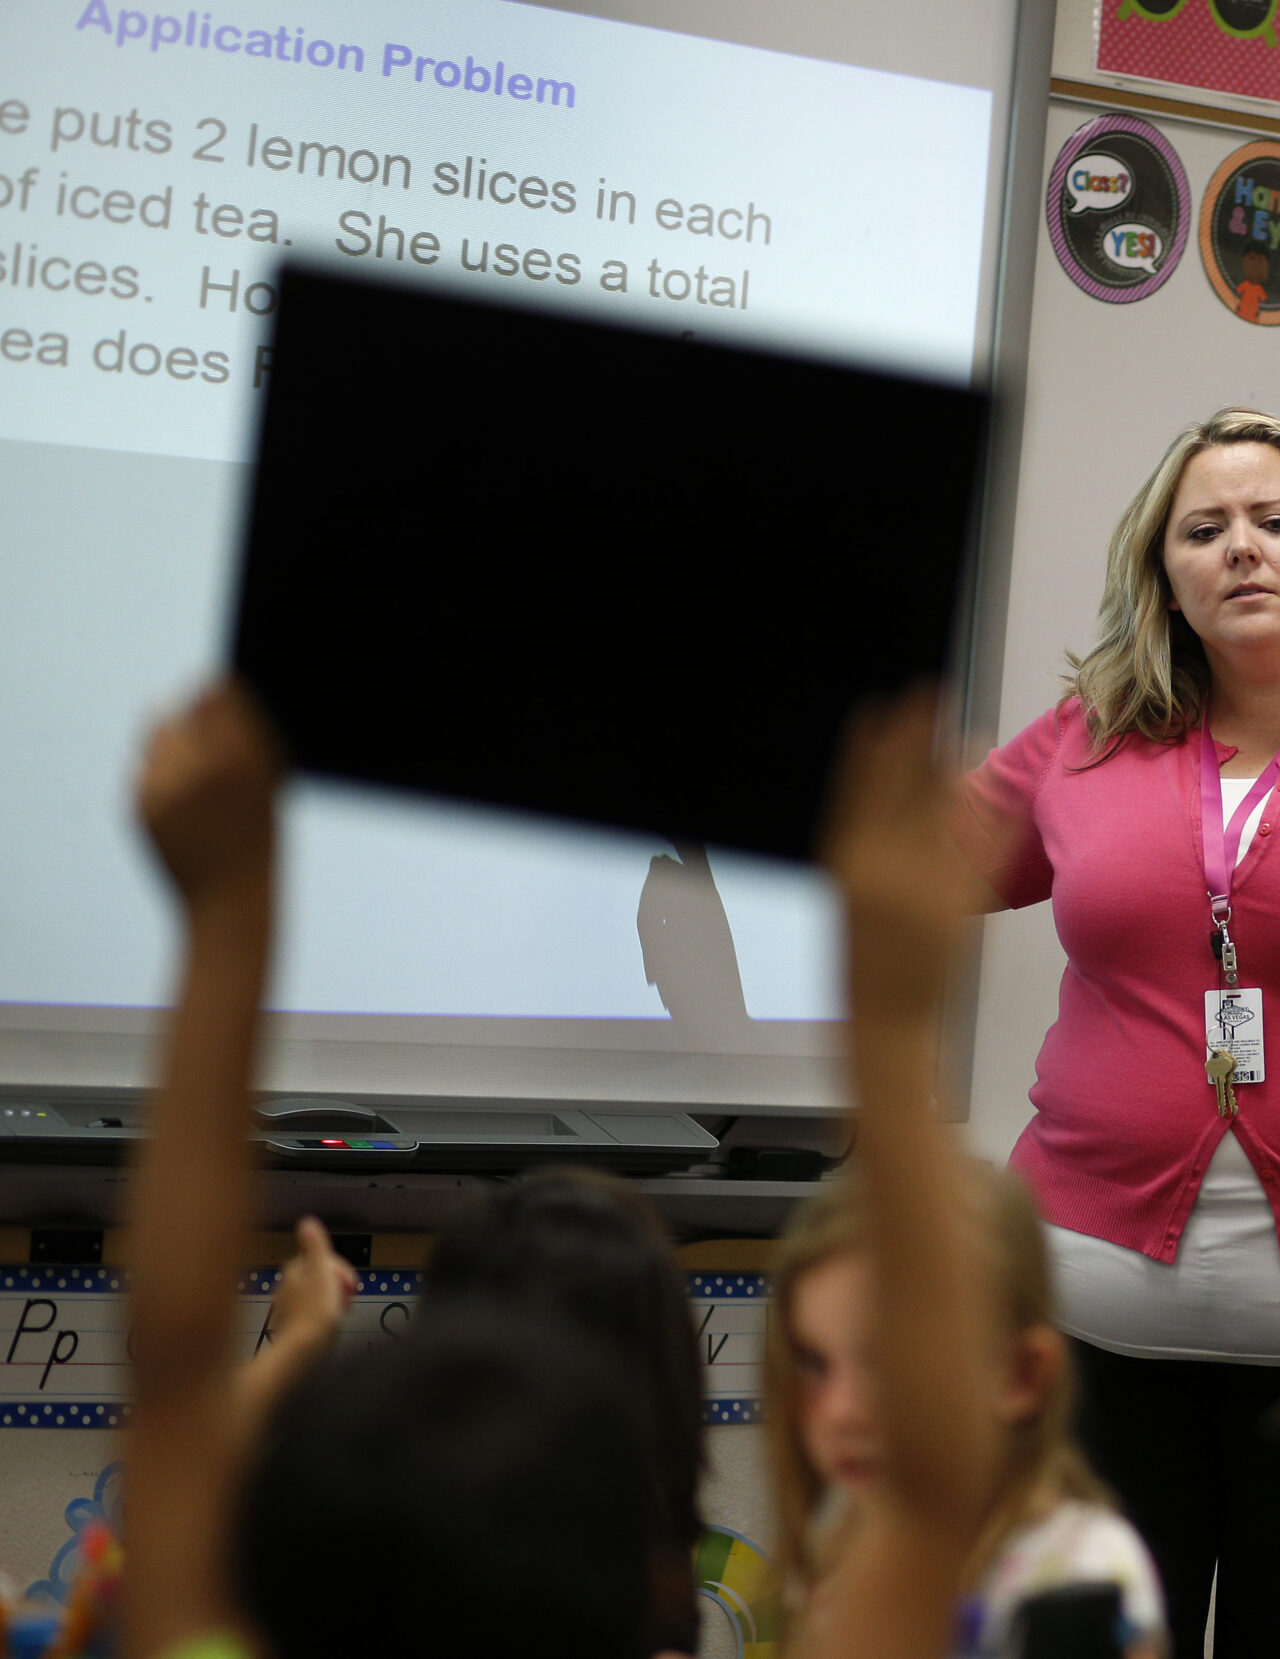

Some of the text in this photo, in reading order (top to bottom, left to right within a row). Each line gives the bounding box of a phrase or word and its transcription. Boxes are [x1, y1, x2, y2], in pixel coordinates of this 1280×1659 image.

[76, 0, 576, 108] Application Problem
[0, 99, 773, 245] e puts 2 lemon slices in each
[1072, 170, 1129, 193] Class?
[56, 171, 173, 230] iced
[193, 192, 293, 246] tea.
[335, 210, 441, 264] She
[460, 235, 582, 285] uses
[600, 255, 628, 293] a
[648, 257, 749, 310] total
[1111, 231, 1155, 258] YES!
[1229, 206, 1247, 236] &
[0, 242, 278, 316] lices. Ho
[0, 328, 69, 367] ea
[92, 329, 230, 384] does
[6, 1298, 79, 1390] Pp
